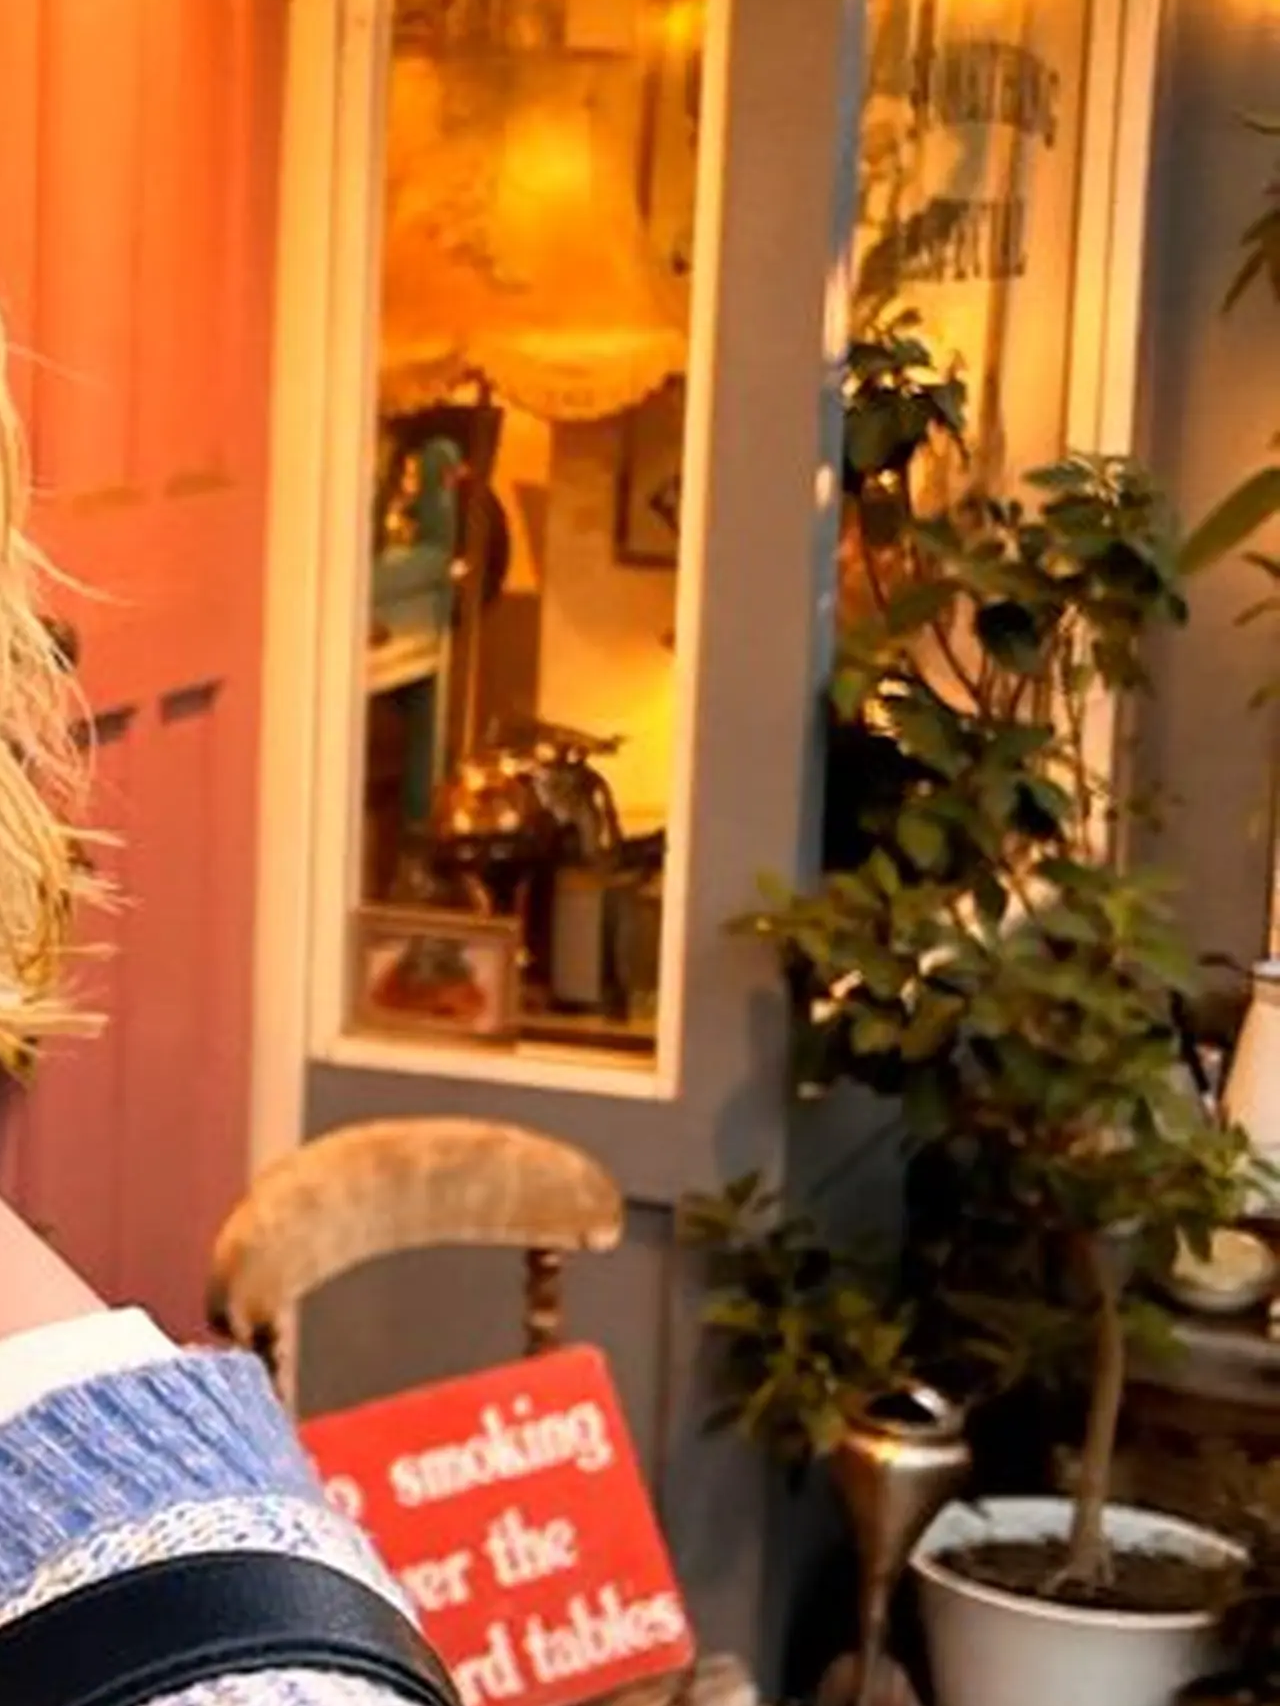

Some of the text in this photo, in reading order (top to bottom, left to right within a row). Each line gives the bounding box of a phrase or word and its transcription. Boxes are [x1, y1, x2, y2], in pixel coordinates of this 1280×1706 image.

[389, 1393, 613, 1507] smoking
[399, 1507, 578, 1612] er the
[523, 1582, 684, 1684] tables
